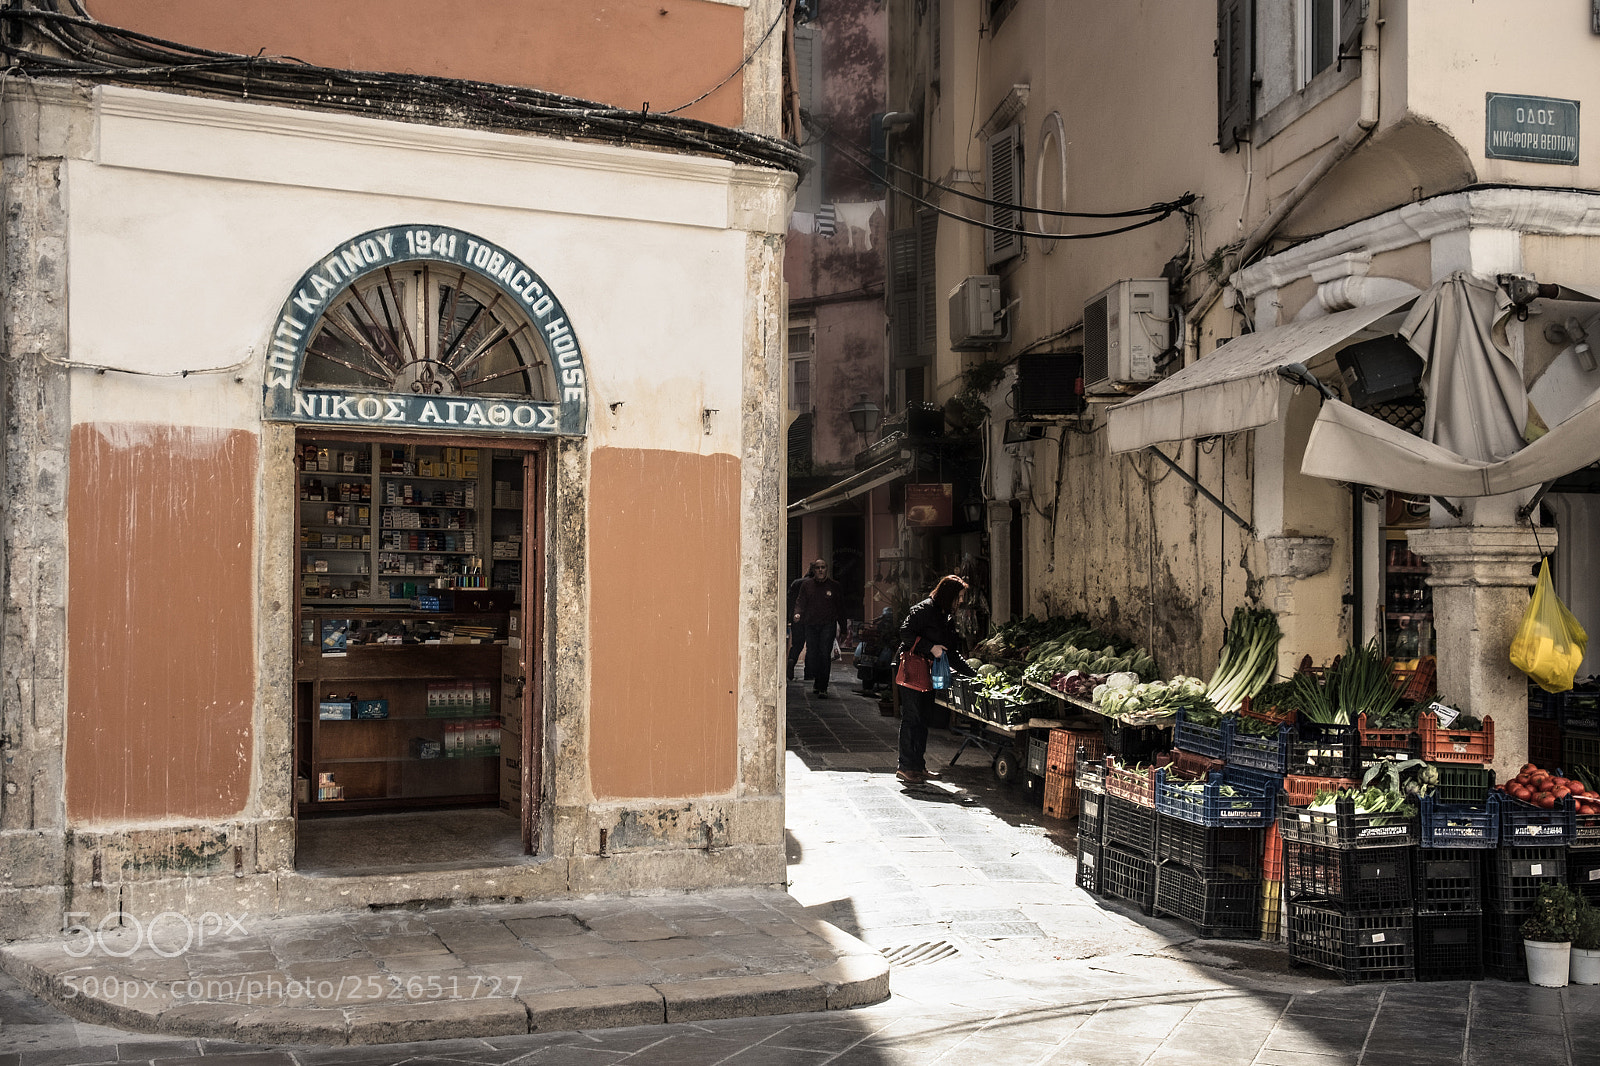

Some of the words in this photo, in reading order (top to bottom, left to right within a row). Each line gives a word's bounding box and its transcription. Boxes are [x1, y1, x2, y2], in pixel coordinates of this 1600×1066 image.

[1516, 108, 1555, 125] ΟΔΟΣ
[266, 314, 307, 389] ΣΠΙΤΙ
[293, 233, 395, 315] ΚΑΠΝΟΥ
[405, 230, 457, 258] 1941
[465, 239, 555, 319] TOBACCO
[544, 316, 586, 403] HOUSE
[292, 392, 407, 421] ΝΙΚΟΣ
[417, 400, 562, 428] ΑΓΑΘΟΣ
